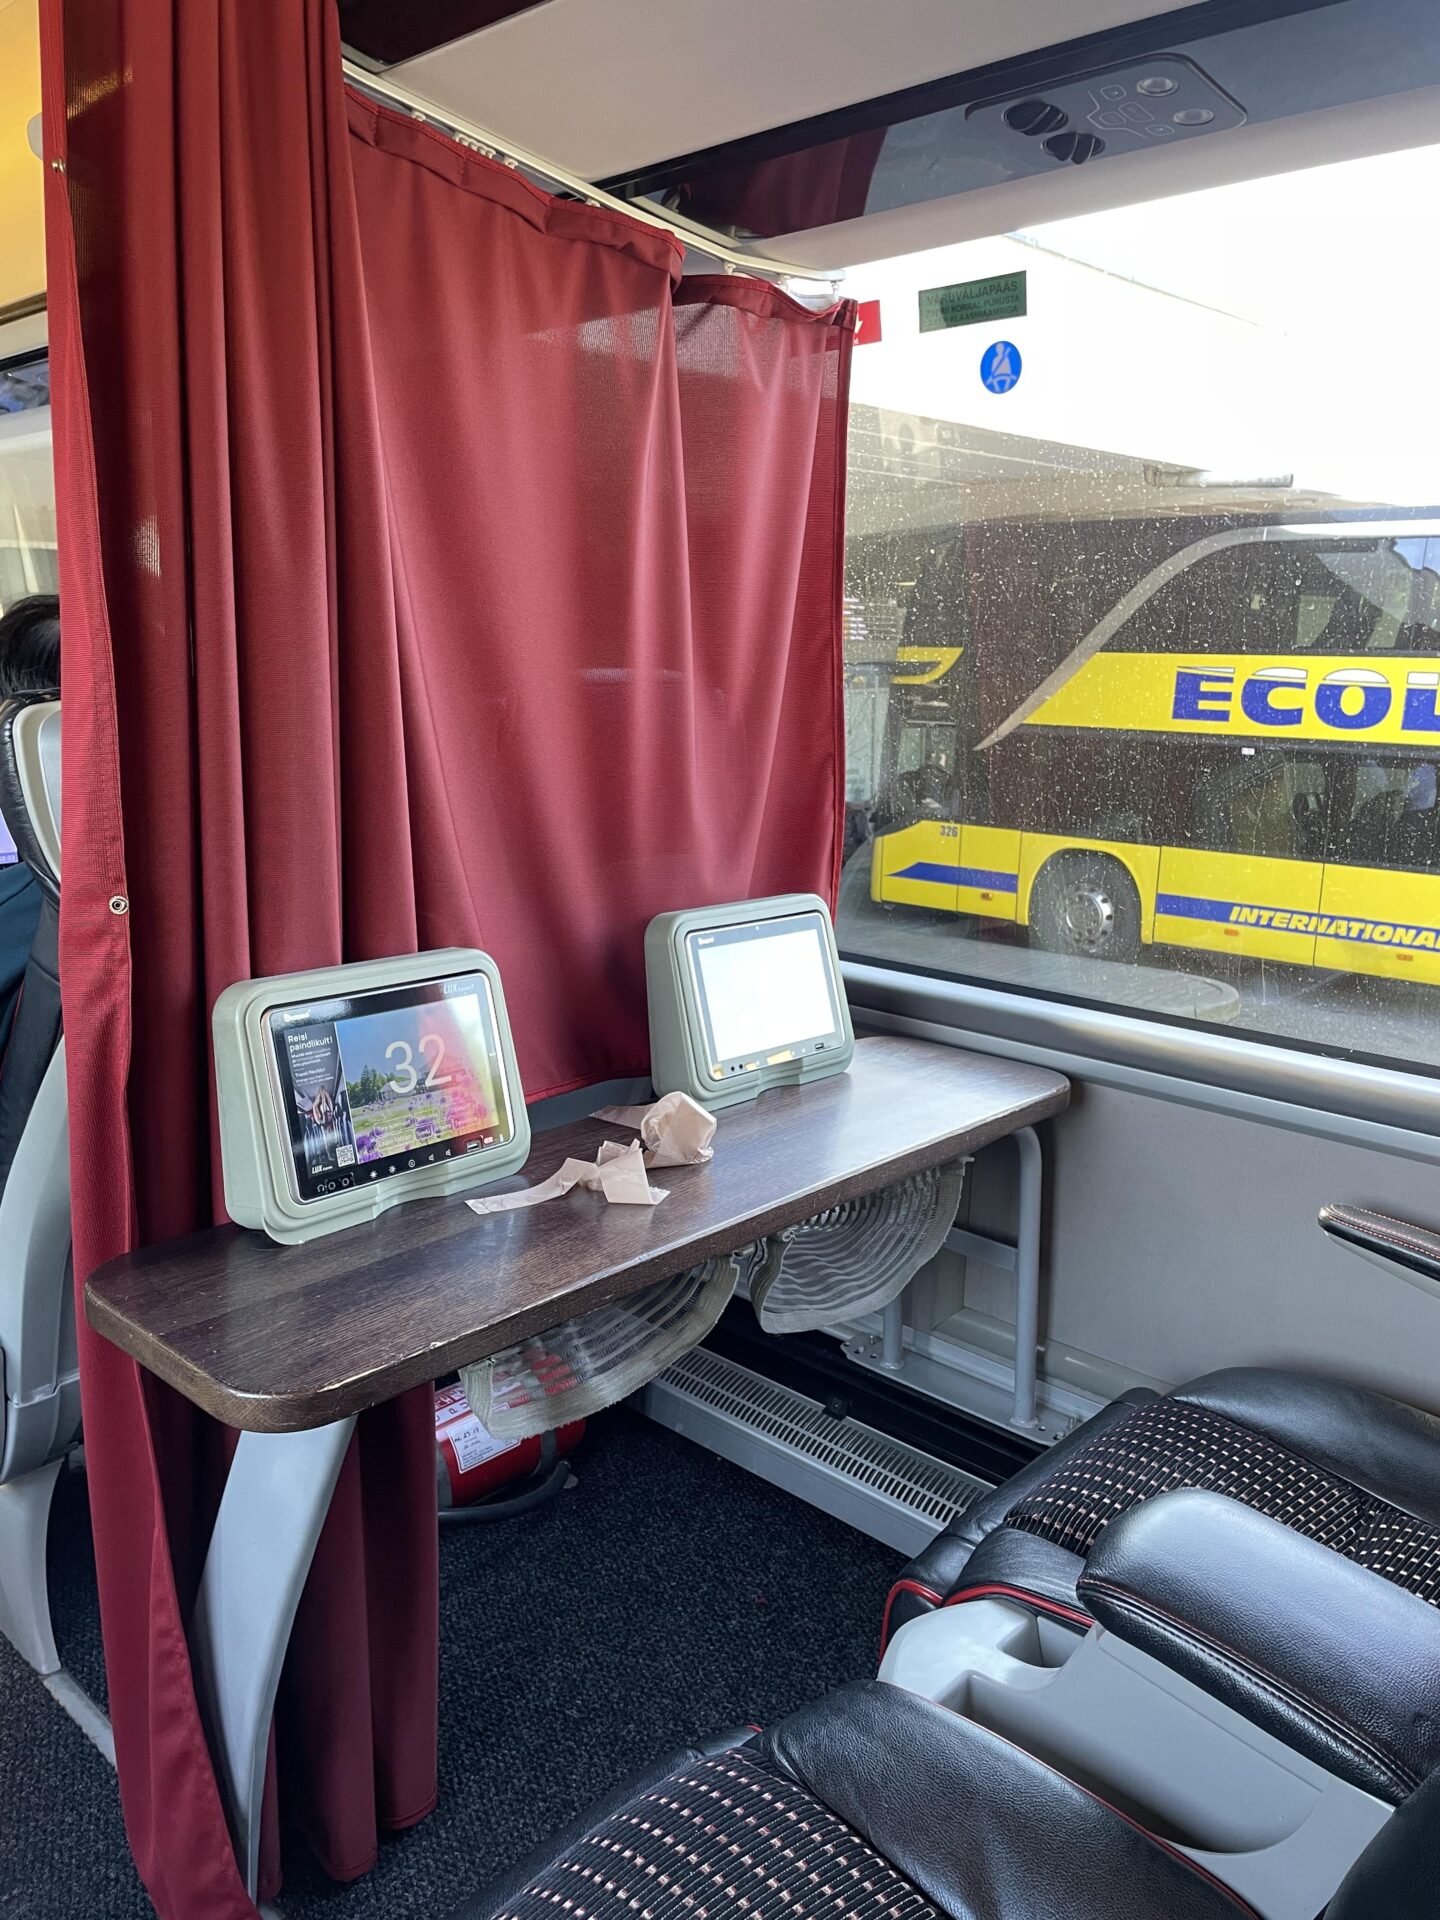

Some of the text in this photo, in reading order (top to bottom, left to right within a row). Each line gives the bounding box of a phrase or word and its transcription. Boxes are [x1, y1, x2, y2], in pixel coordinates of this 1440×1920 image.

[1172, 666, 1440, 732] ECOL
[940, 825, 958, 838] 326
[1229, 906, 1440, 949] INTERNATIONA
[385, 1033, 453, 1094] 32
